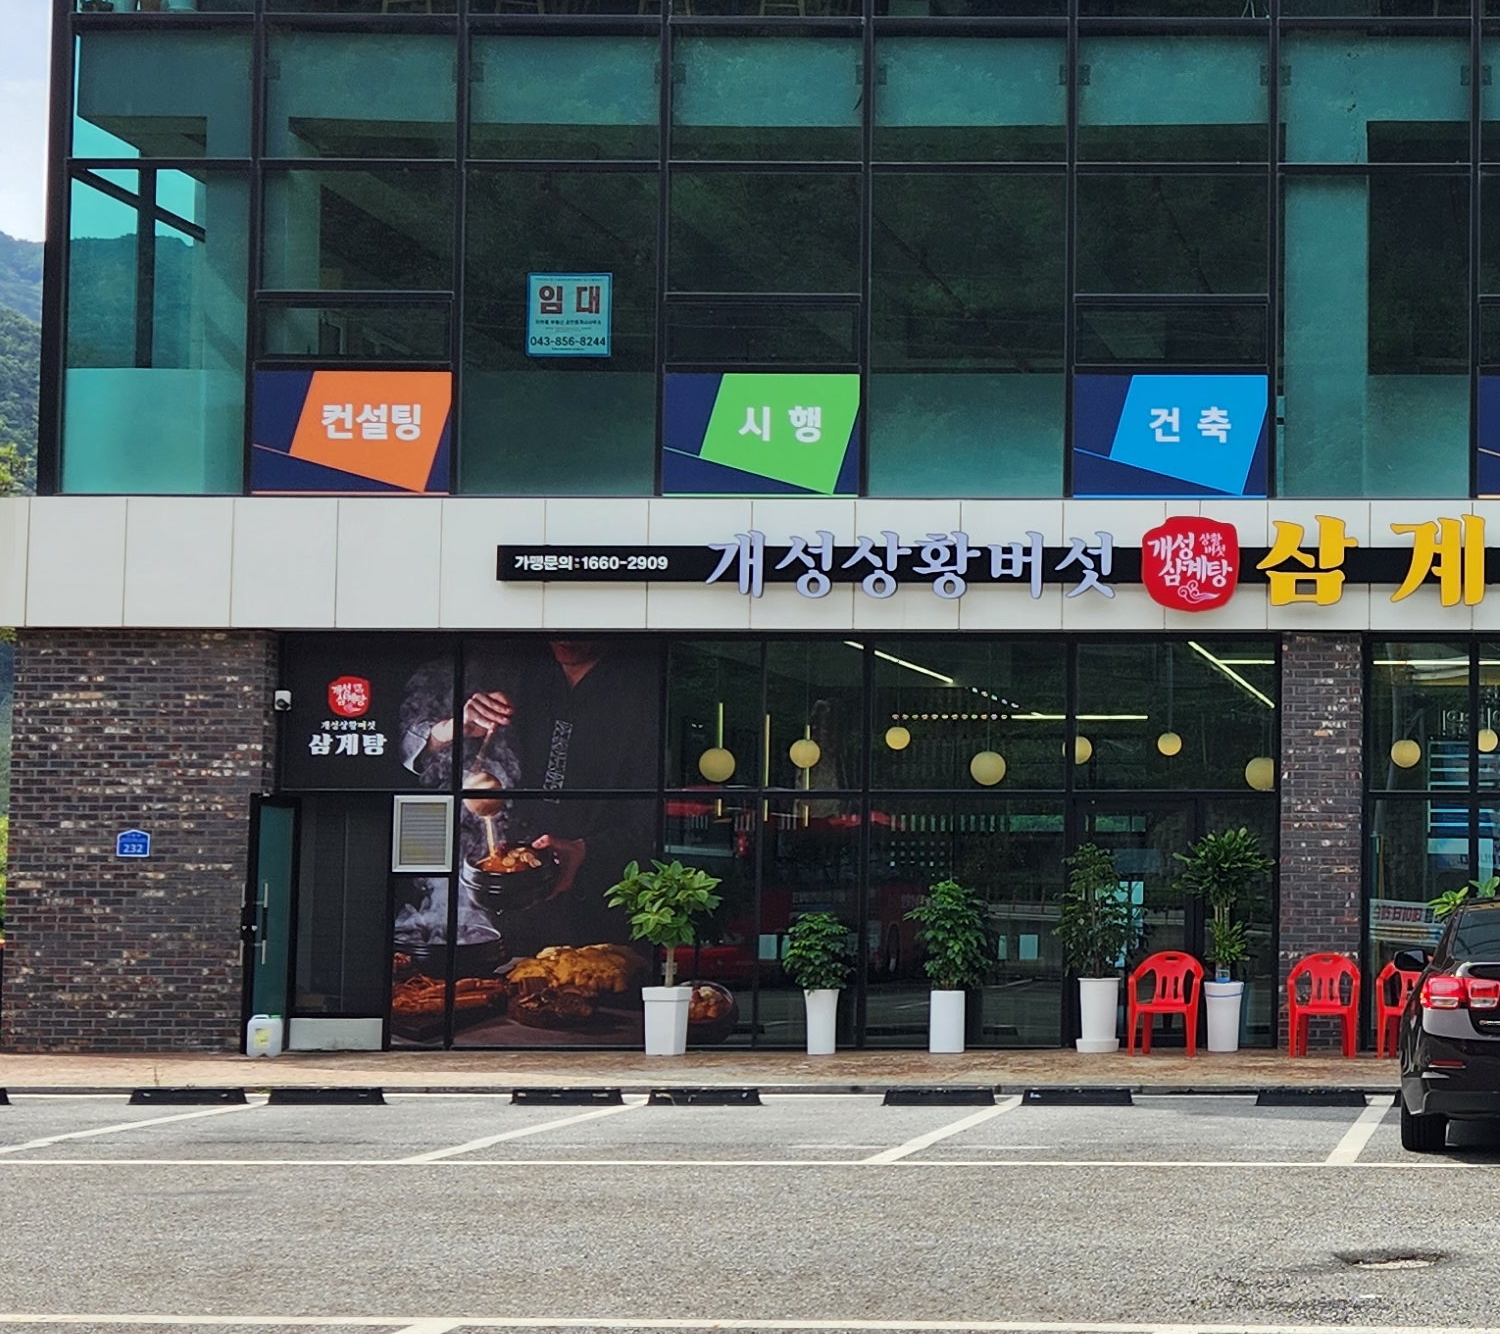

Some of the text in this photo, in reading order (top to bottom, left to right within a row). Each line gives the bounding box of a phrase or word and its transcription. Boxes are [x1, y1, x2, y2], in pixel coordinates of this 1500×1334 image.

[530, 336, 607, 347] 043-856-8244
[321, 403, 422, 442] 컨설팅
[704, 529, 1117, 600] 개성상황버섯
[1157, 554, 1234, 588] 삼계탕
[308, 733, 388, 757] 삼계탕
[123, 843, 144, 854] 232
